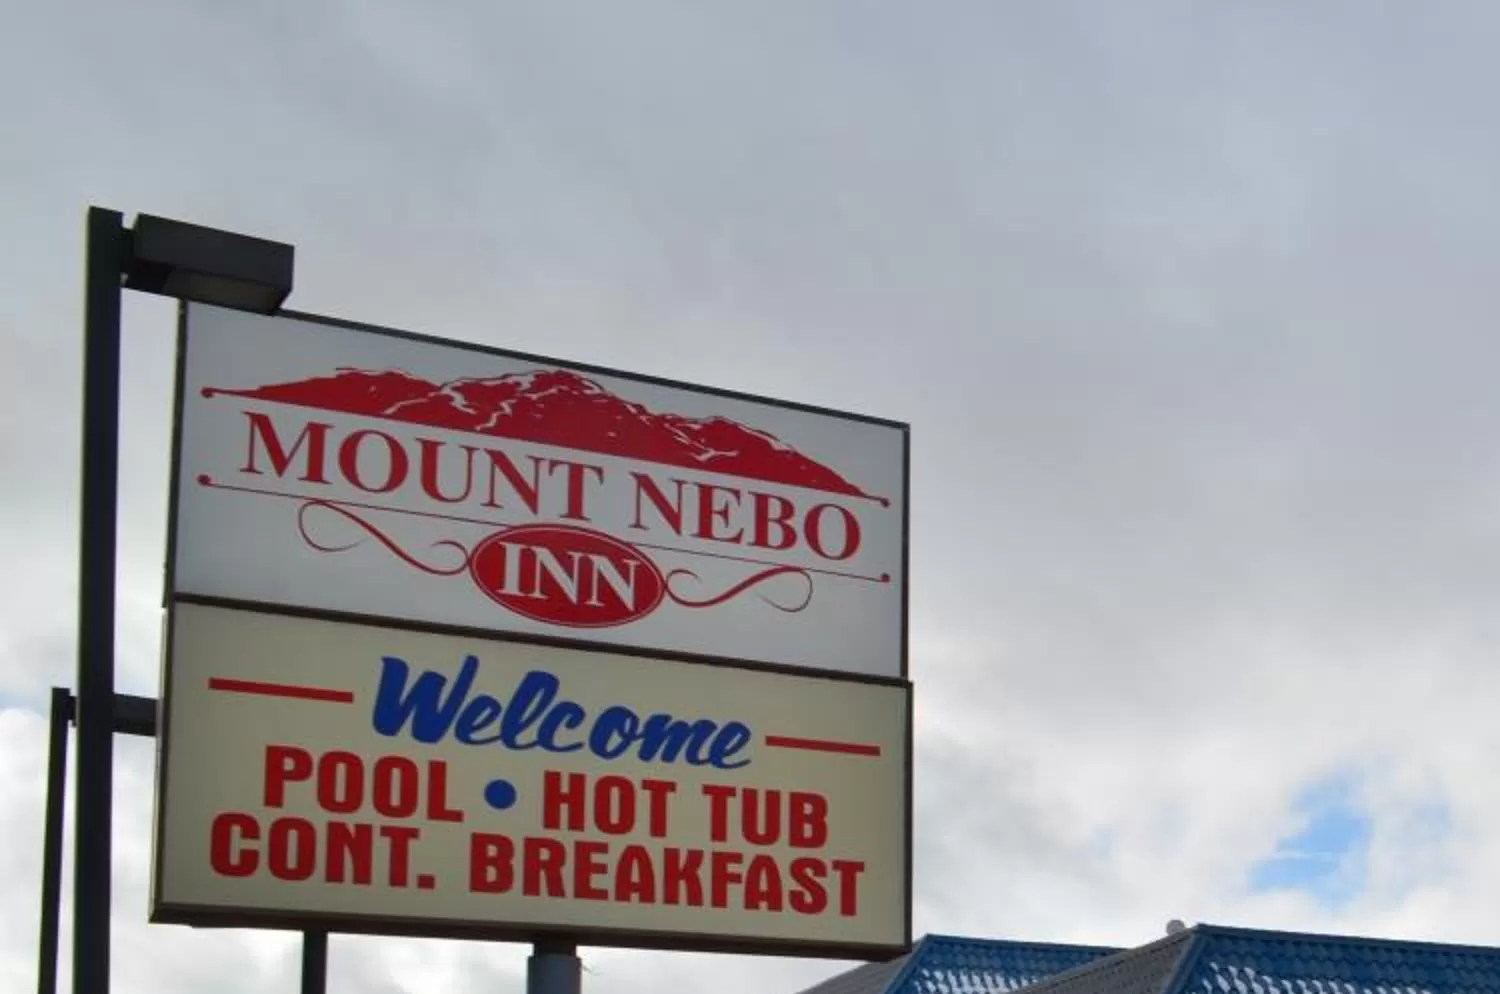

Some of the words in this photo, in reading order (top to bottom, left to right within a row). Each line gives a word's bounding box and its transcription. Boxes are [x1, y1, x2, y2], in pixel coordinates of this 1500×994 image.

[239, 410, 605, 523] MOUNT
[628, 470, 862, 561] NEBO
[500, 543, 642, 609] INN
[371, 655, 751, 770] Welcome
[263, 744, 465, 824] POOL
[543, 770, 678, 841] HOT
[702, 784, 830, 851] TUB
[210, 811, 437, 892] CONT.
[468, 831, 866, 919] BREAKFAST
